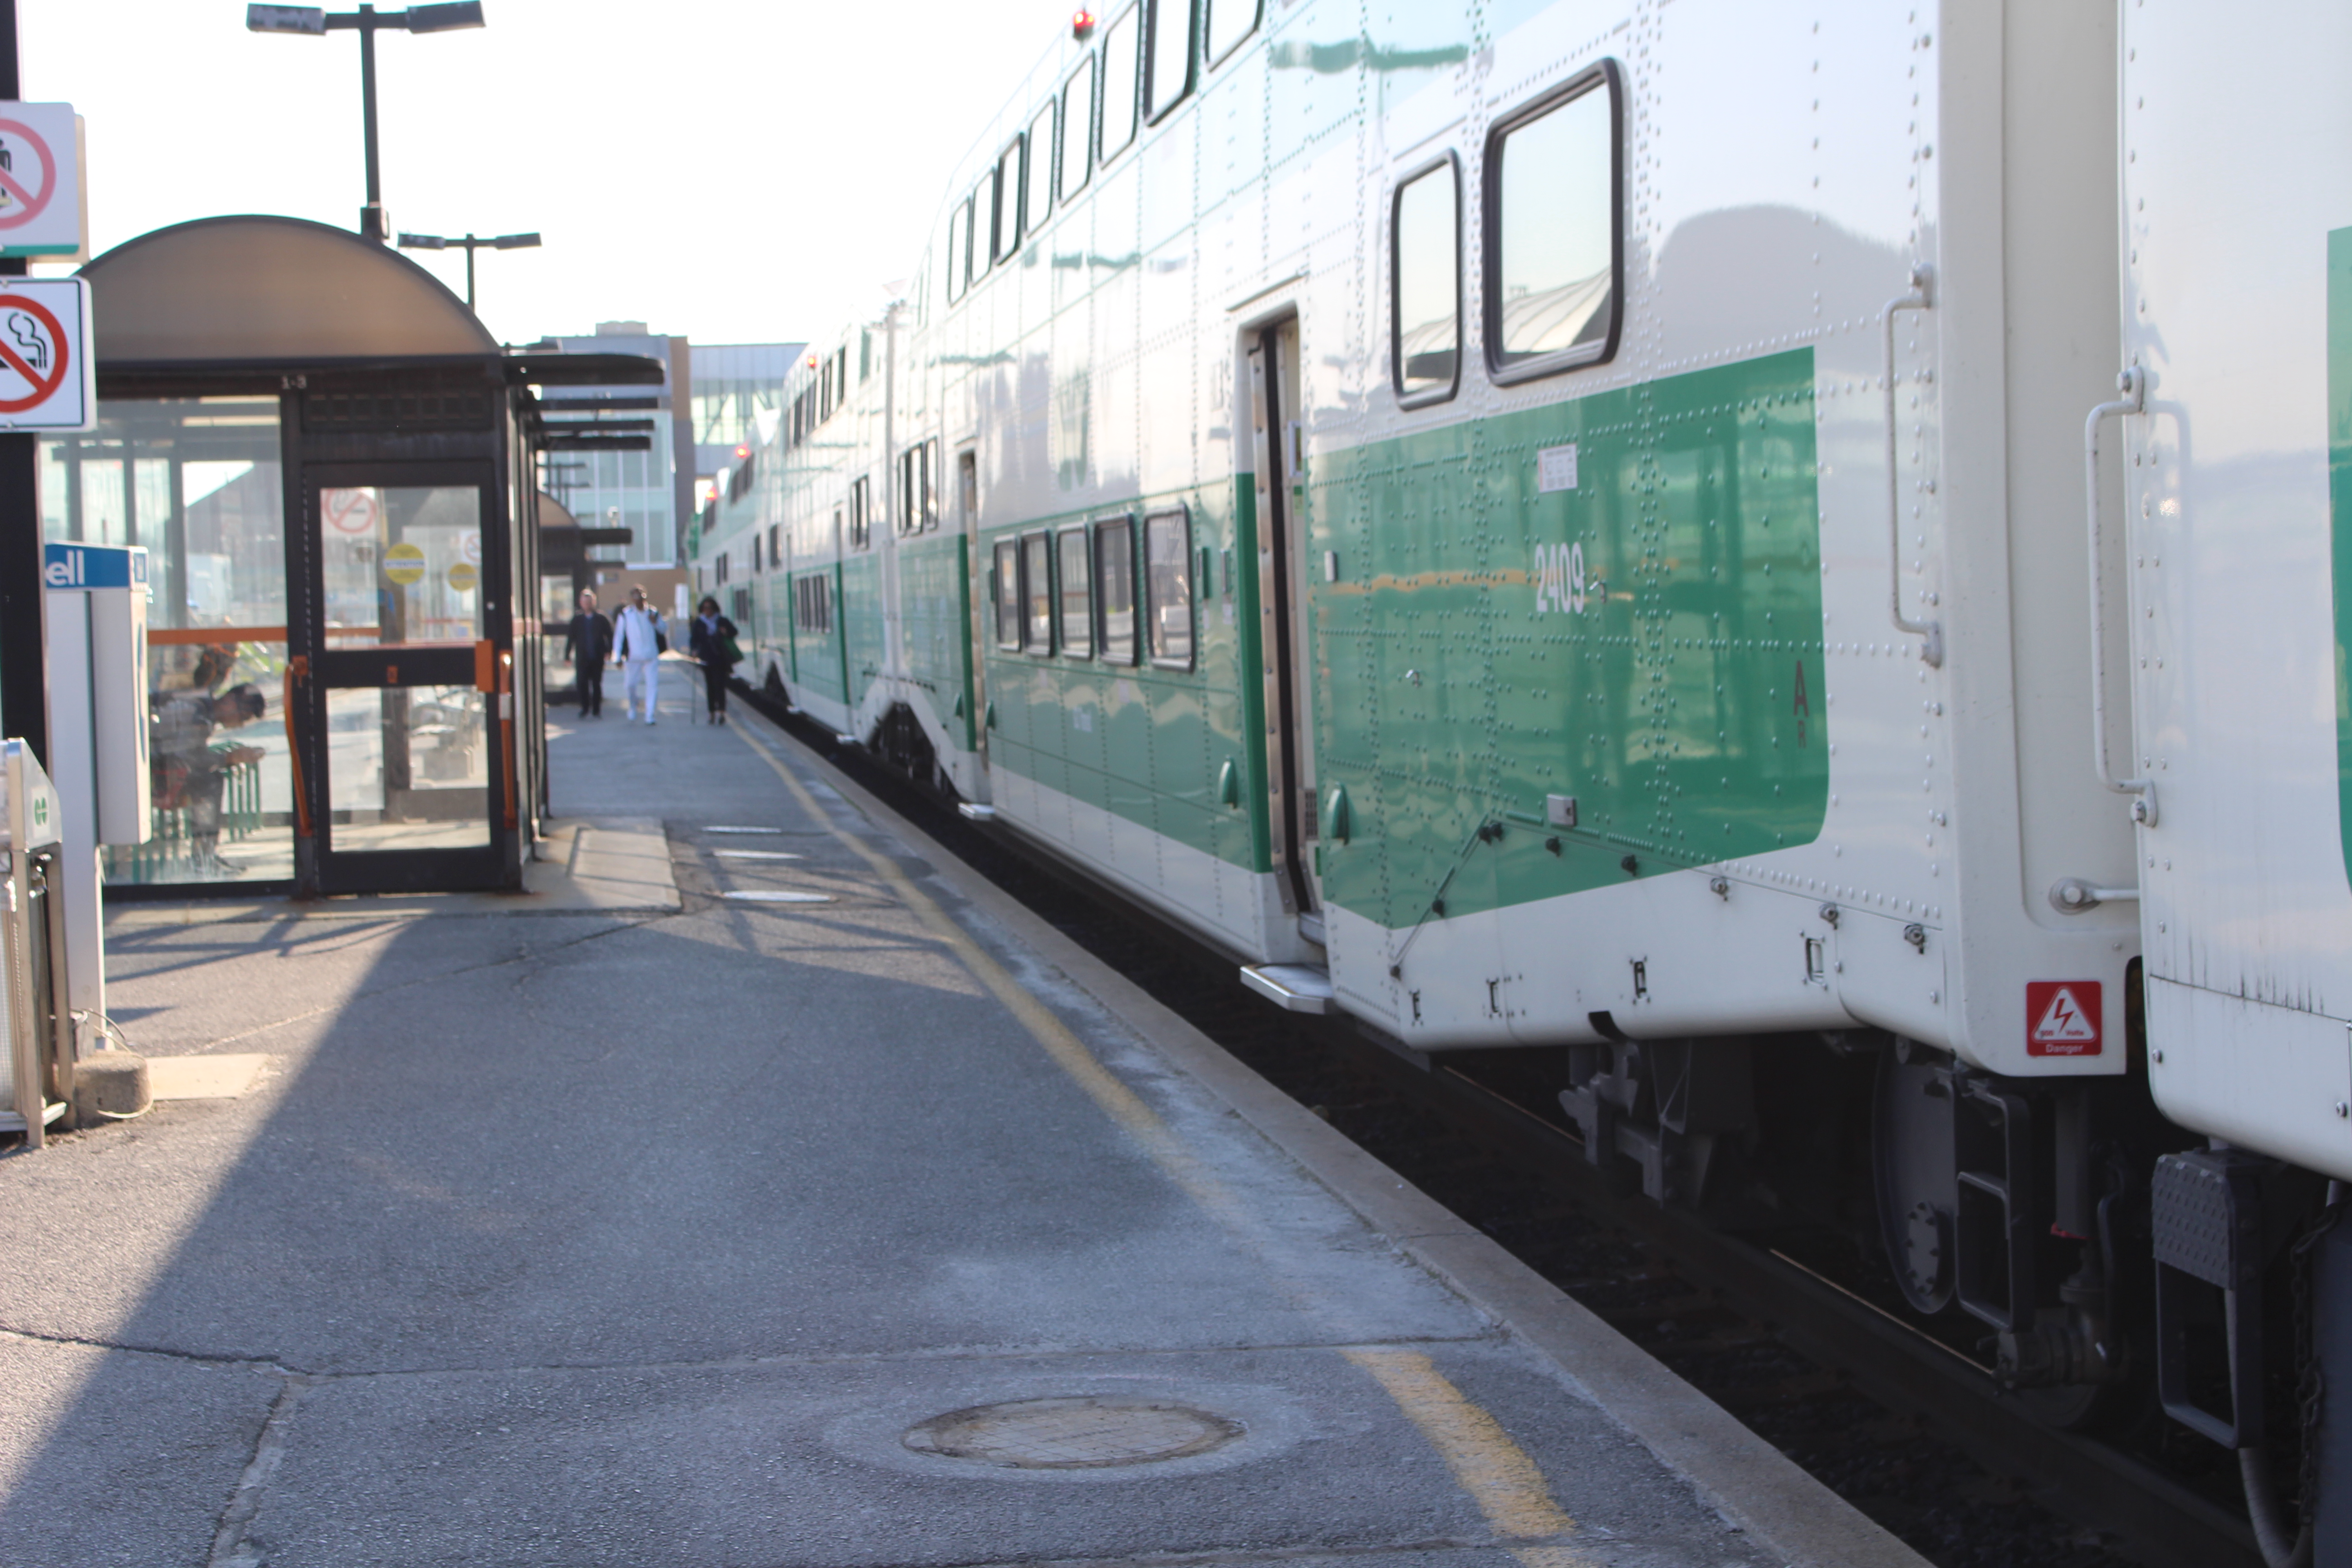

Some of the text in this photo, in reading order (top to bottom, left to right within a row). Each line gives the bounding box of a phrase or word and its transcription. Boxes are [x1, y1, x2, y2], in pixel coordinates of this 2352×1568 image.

[46, 549, 85, 586] ell
[1535, 542, 1585, 615] 2409
[1793, 660, 1809, 718] A
[2046, 1044, 2083, 1054] Danger
